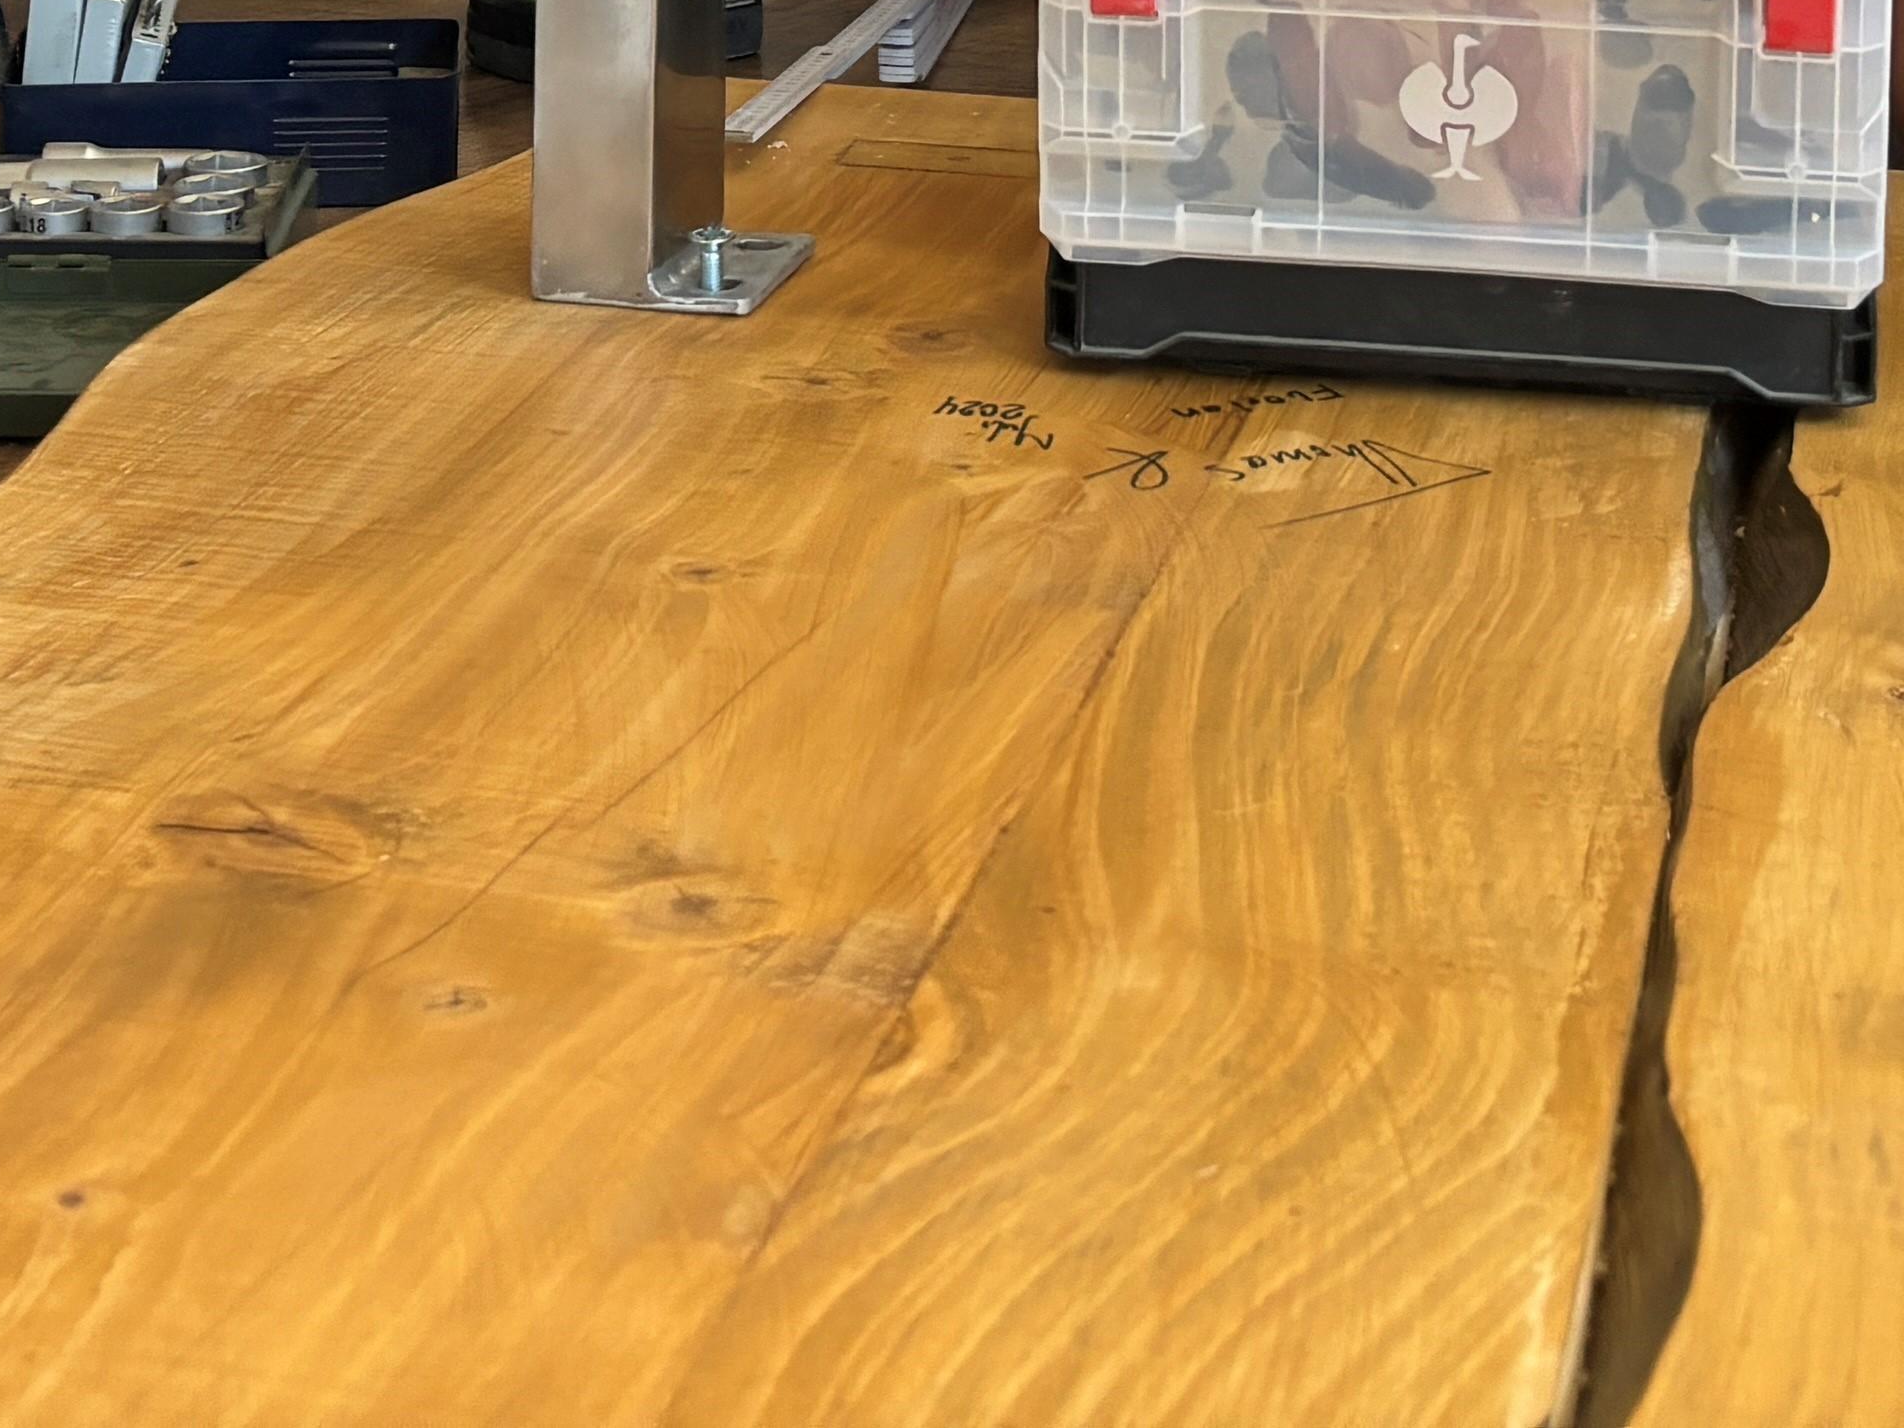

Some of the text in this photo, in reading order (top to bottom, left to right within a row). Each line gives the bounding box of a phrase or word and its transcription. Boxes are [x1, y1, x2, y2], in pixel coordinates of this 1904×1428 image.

[29, 217, 46, 233] 18
[932, 396, 1026, 424] 2024
[1082, 447, 1169, 490] &
